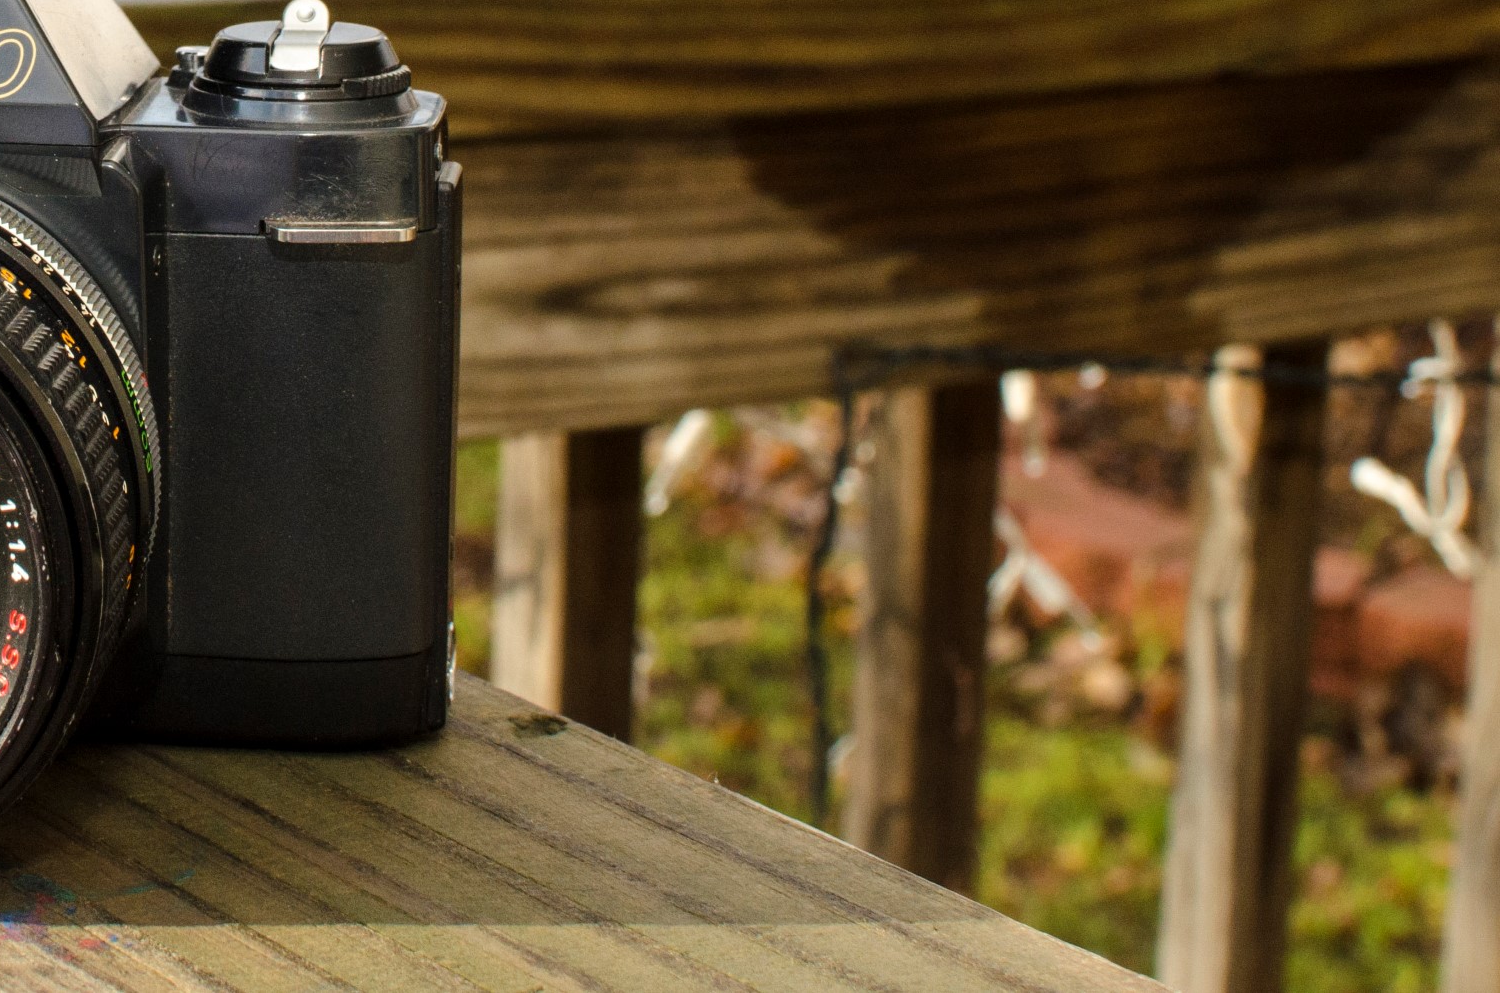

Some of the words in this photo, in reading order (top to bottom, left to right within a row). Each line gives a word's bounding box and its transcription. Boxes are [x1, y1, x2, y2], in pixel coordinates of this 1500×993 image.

[11, 236, 23, 247] 4
[0, 267, 32, 300] 1.5
[62, 283, 73, 295] 2
[80, 303, 97, 327] 1.4
[61, 329, 87, 369] 1.2
[0, 499, 30, 583] 1:1.4
